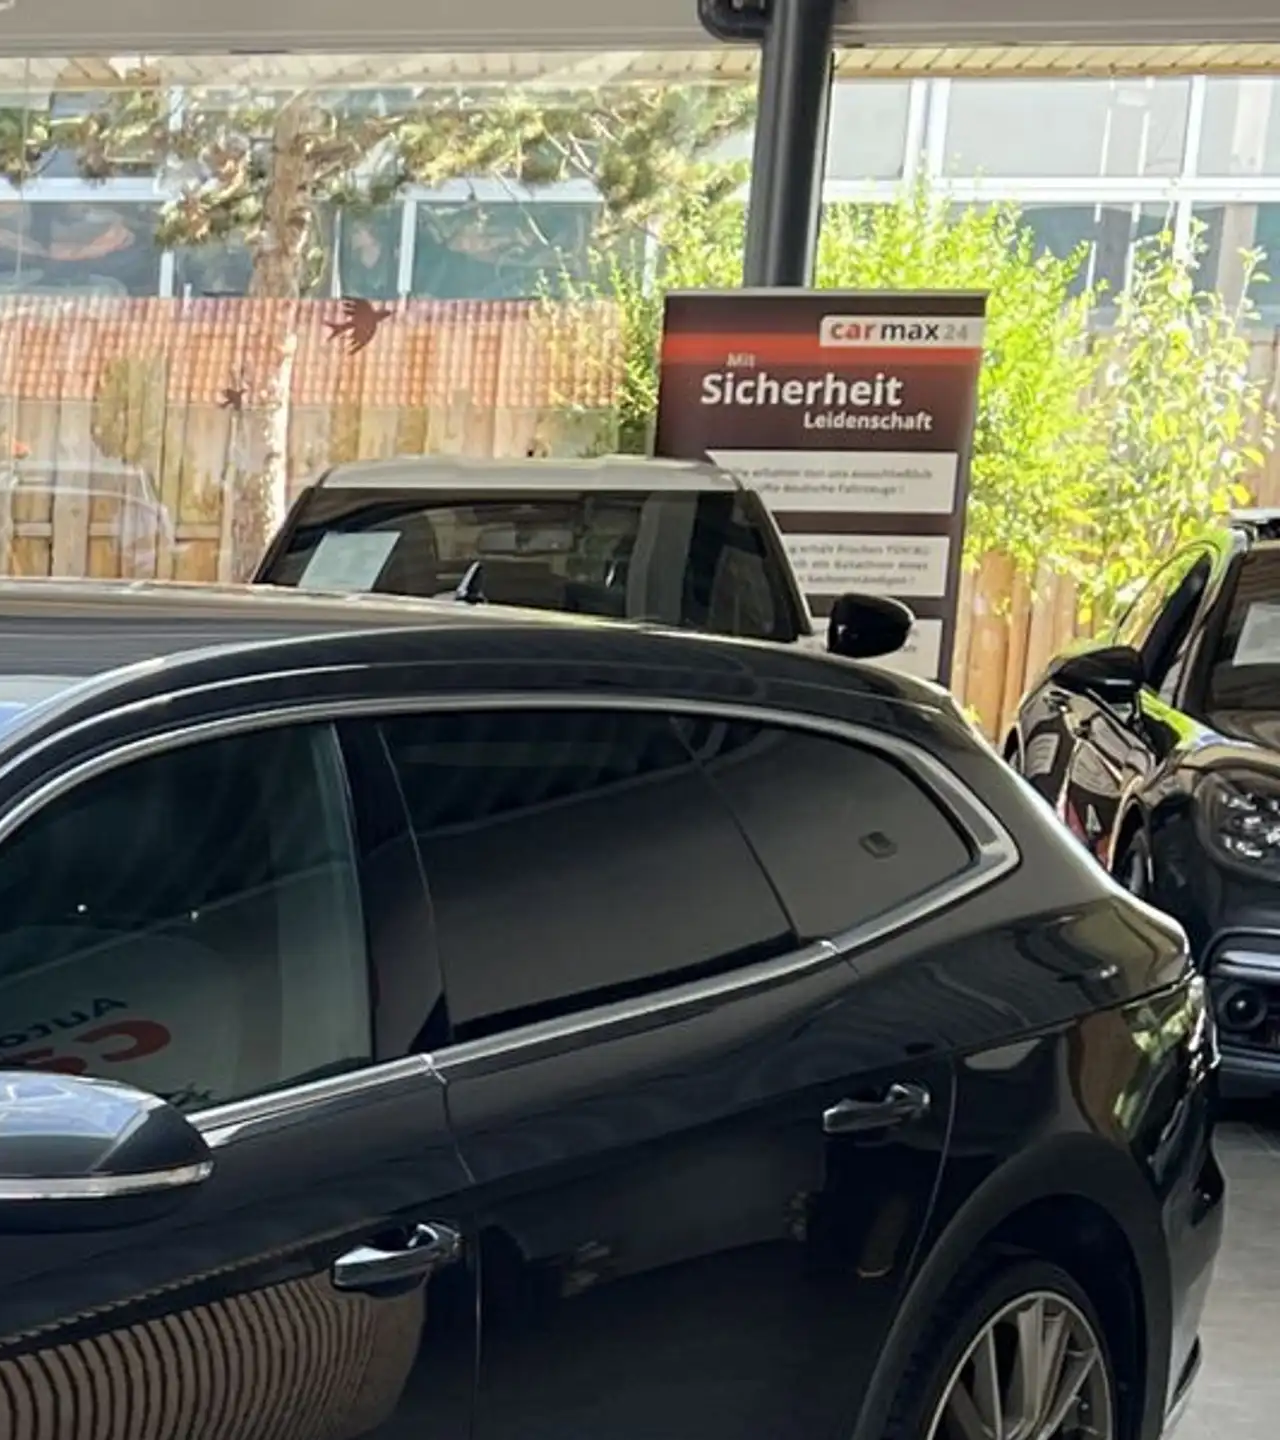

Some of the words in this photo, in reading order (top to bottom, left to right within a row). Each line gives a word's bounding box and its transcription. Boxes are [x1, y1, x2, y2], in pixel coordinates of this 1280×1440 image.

[727, 352, 757, 369] Mit
[700, 372, 904, 407] Sicherheit
[803, 410, 934, 432] Leidenschaft
